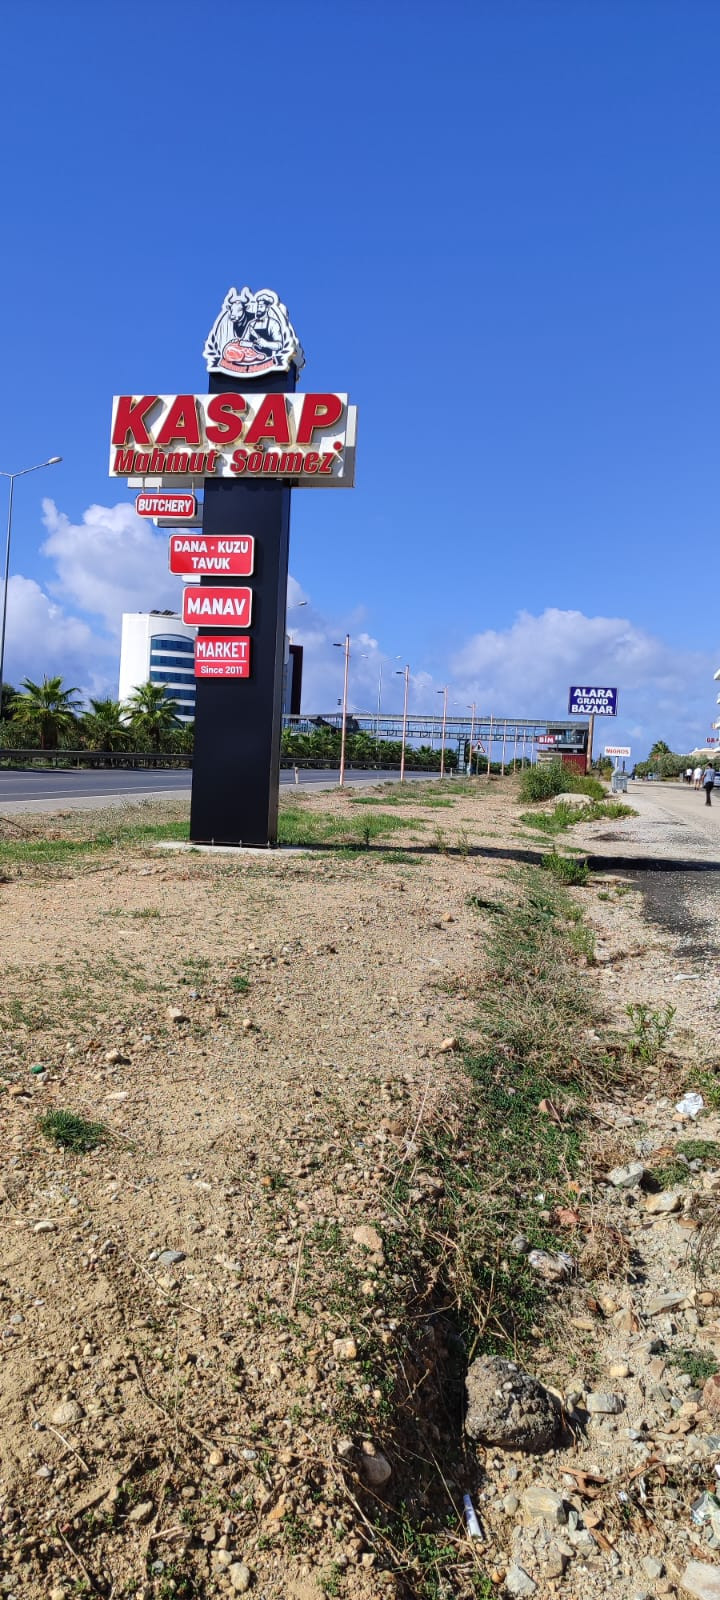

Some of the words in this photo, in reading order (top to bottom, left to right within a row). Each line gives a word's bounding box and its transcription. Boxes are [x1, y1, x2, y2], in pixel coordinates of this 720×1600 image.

[111, 393, 342, 445] KASAP
[113, 448, 218, 474] Mahmut
[230, 446, 334, 474] Sönmez
[137, 498, 193, 513] BUTCHERY
[174, 540, 207, 553] DANA
[217, 540, 249, 554] KUZU
[191, 557, 230, 570] TAVUK
[187, 597, 246, 616] MANAV
[196, 641, 248, 658] MARKET
[200, 665, 224, 675] Since
[225, 665, 243, 675] 2011
[573, 689, 613, 698] ALARA
[571, 704, 613, 714] BAZAAR
